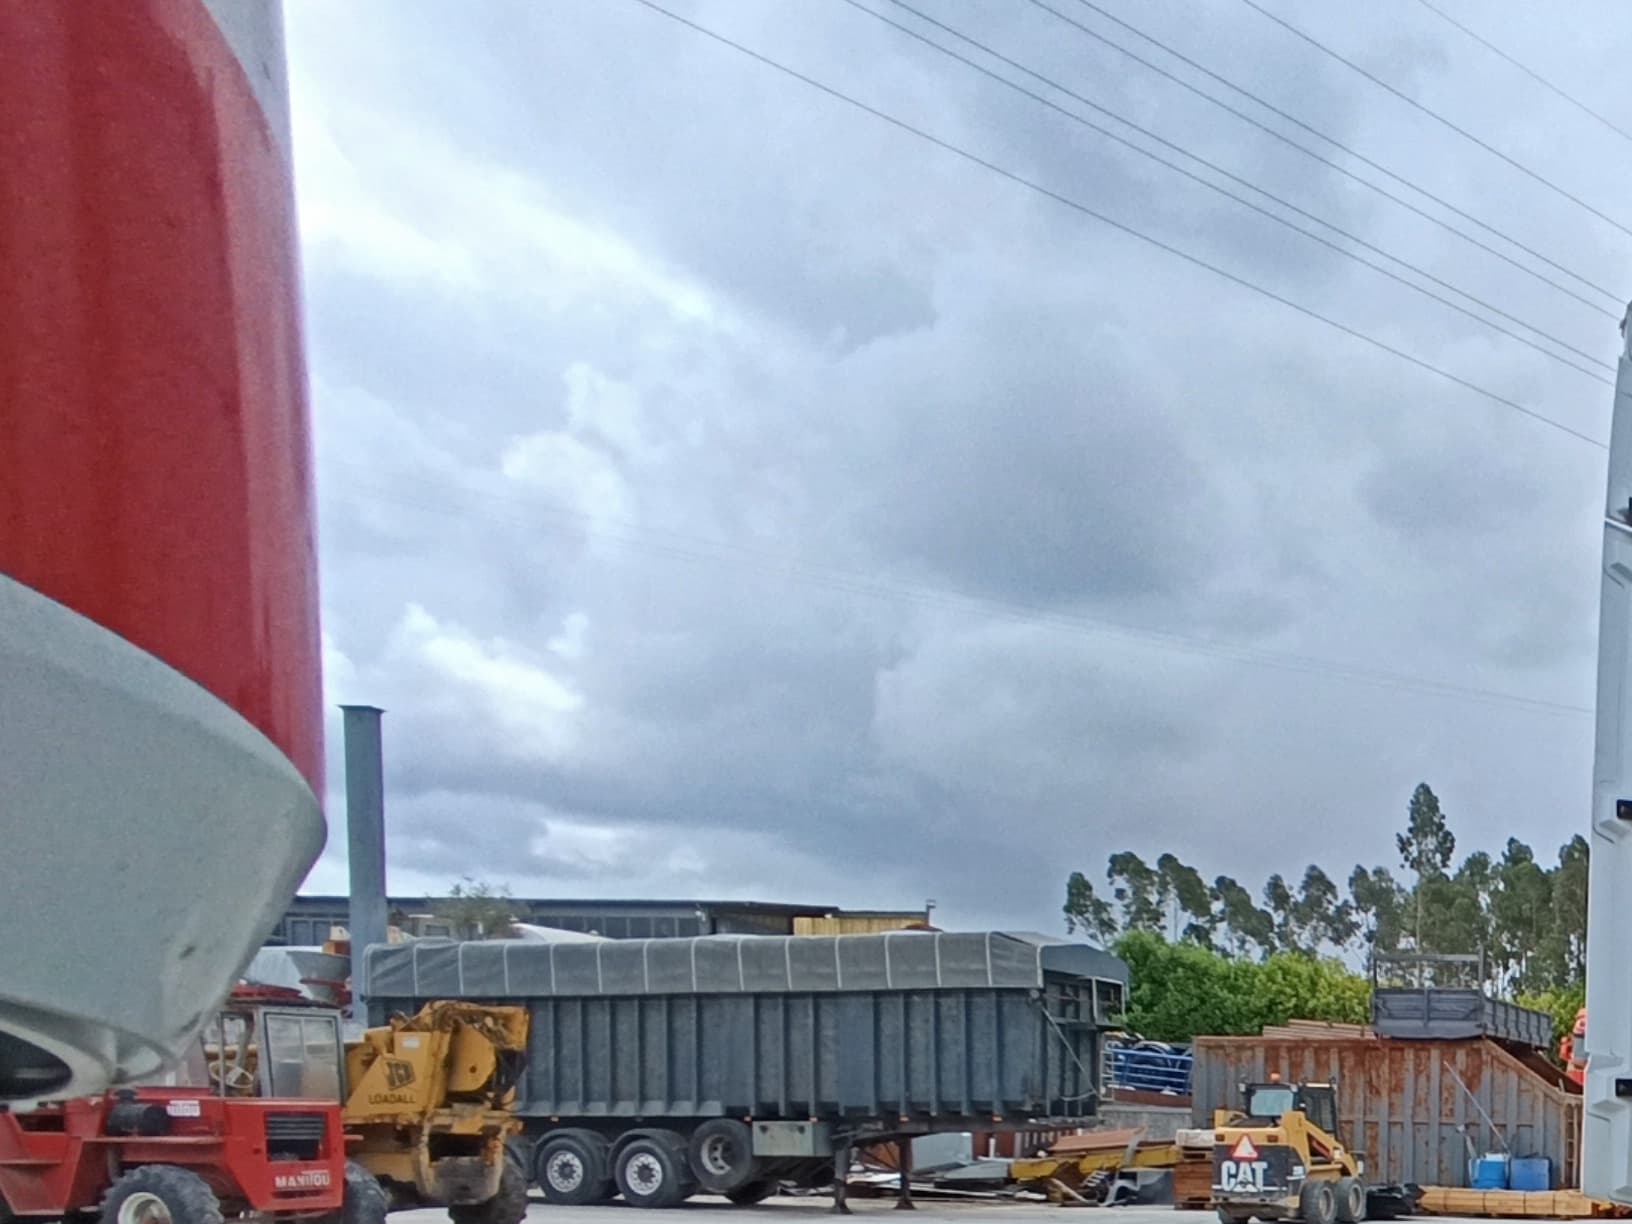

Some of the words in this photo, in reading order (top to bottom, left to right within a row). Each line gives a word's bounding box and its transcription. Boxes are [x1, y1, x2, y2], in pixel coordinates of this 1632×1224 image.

[368, 1093, 416, 1105] LOADALL
[274, 1169, 331, 1188] MANITOU
[1221, 1160, 1268, 1192] CAT
